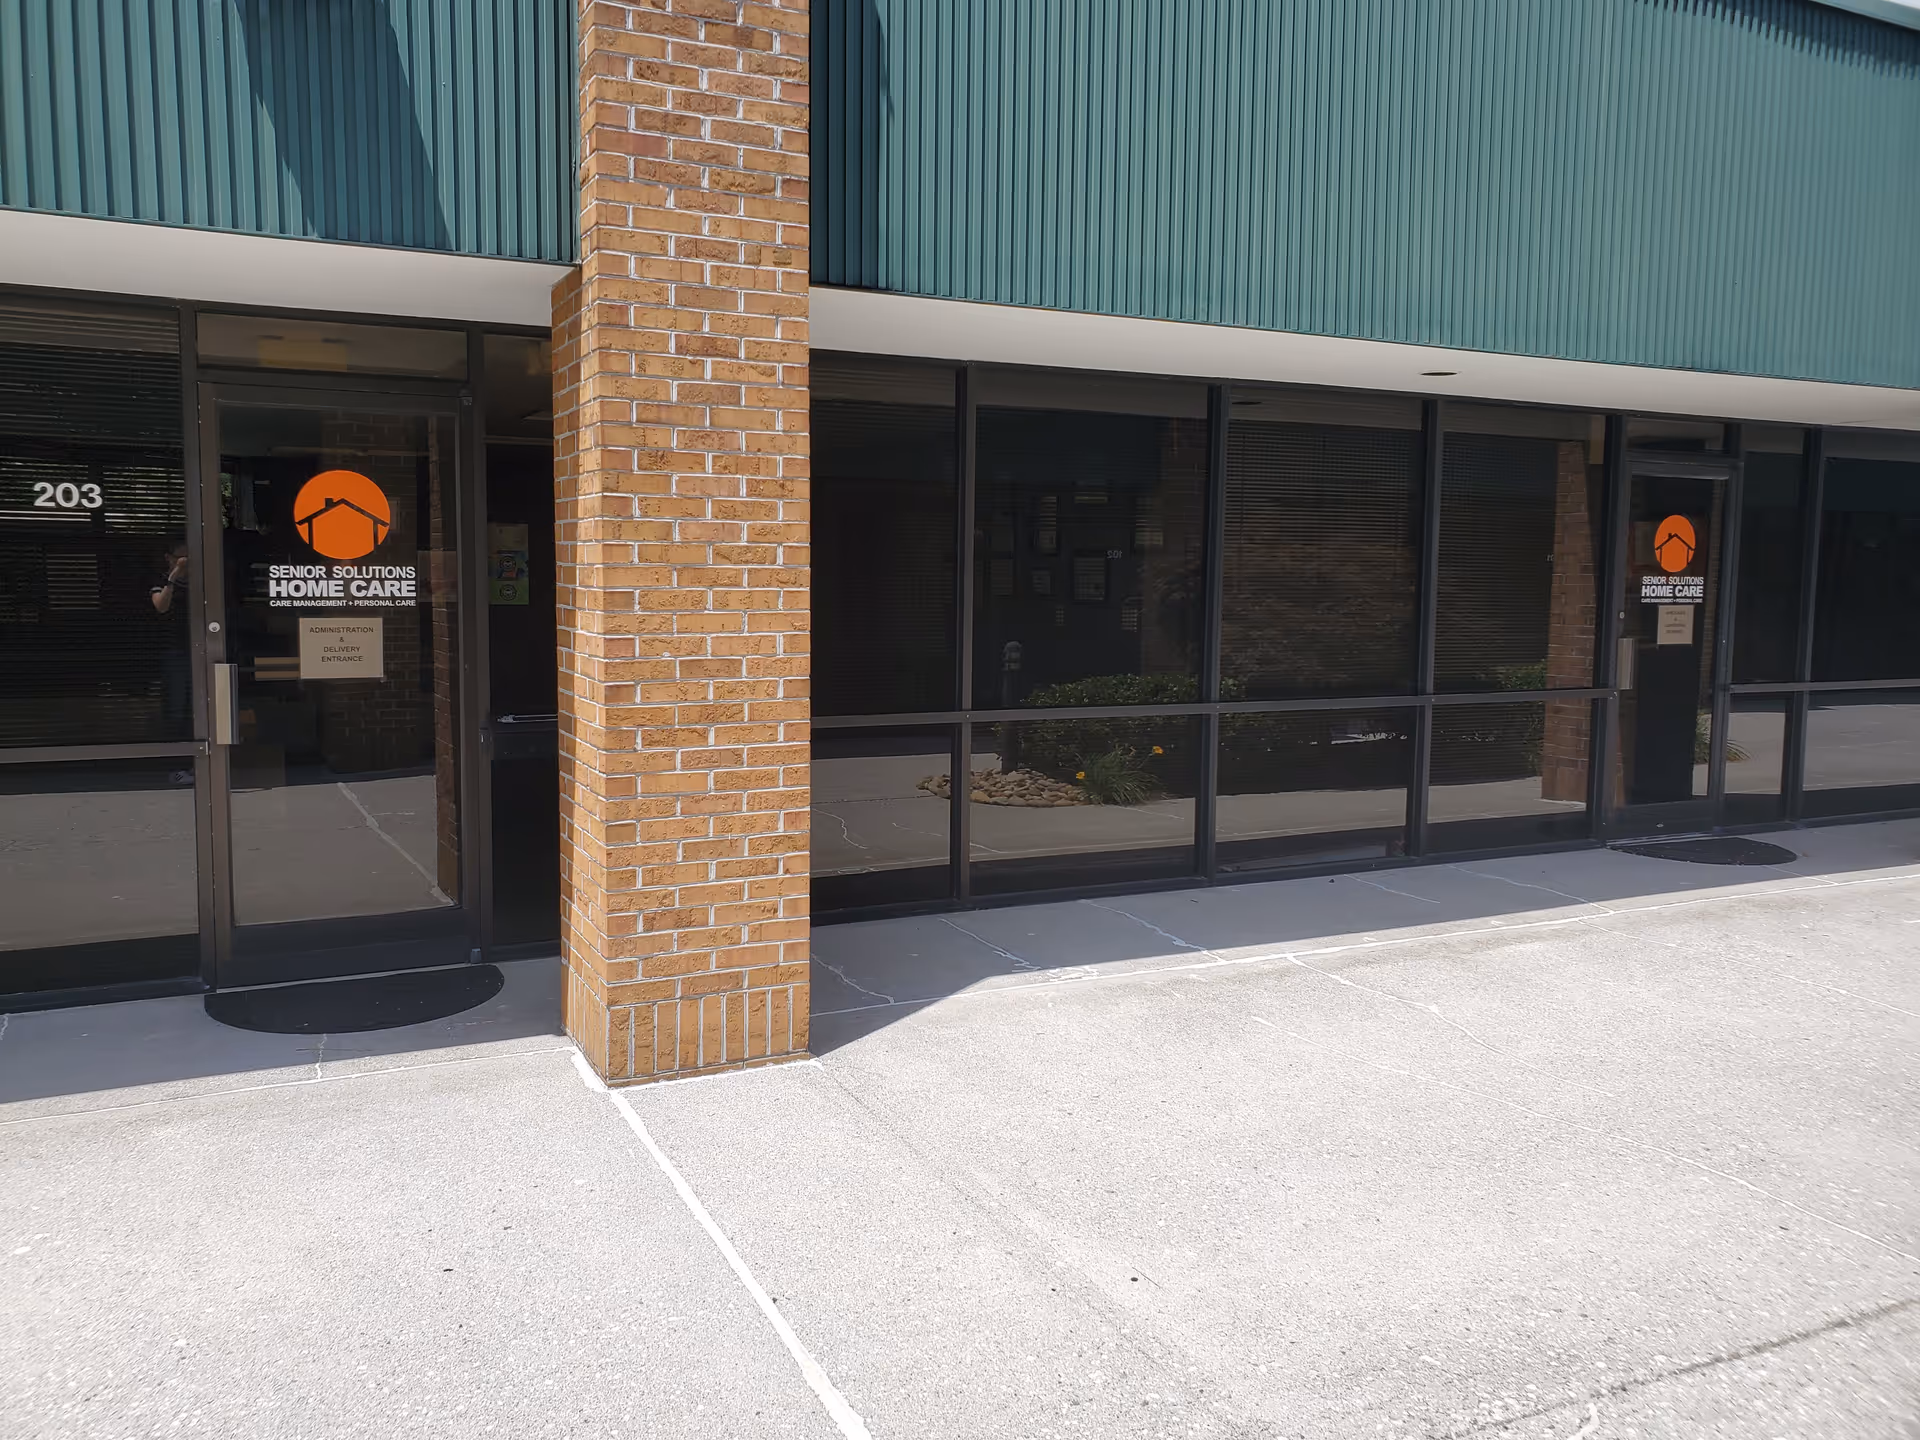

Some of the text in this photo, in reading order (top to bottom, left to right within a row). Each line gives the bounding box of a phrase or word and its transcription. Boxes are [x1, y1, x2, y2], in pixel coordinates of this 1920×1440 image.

[33, 482, 103, 508] 203
[269, 565, 416, 579] SENIOR SOLUTIONS
[1642, 576, 1704, 585] SENIOR SOLUTIONS
[269, 580, 416, 597] HOME CARE
[1641, 585, 1704, 597] HOME CARE
[309, 626, 374, 634] ADMINISTRATION
[321, 655, 364, 663] ENTRANCE
